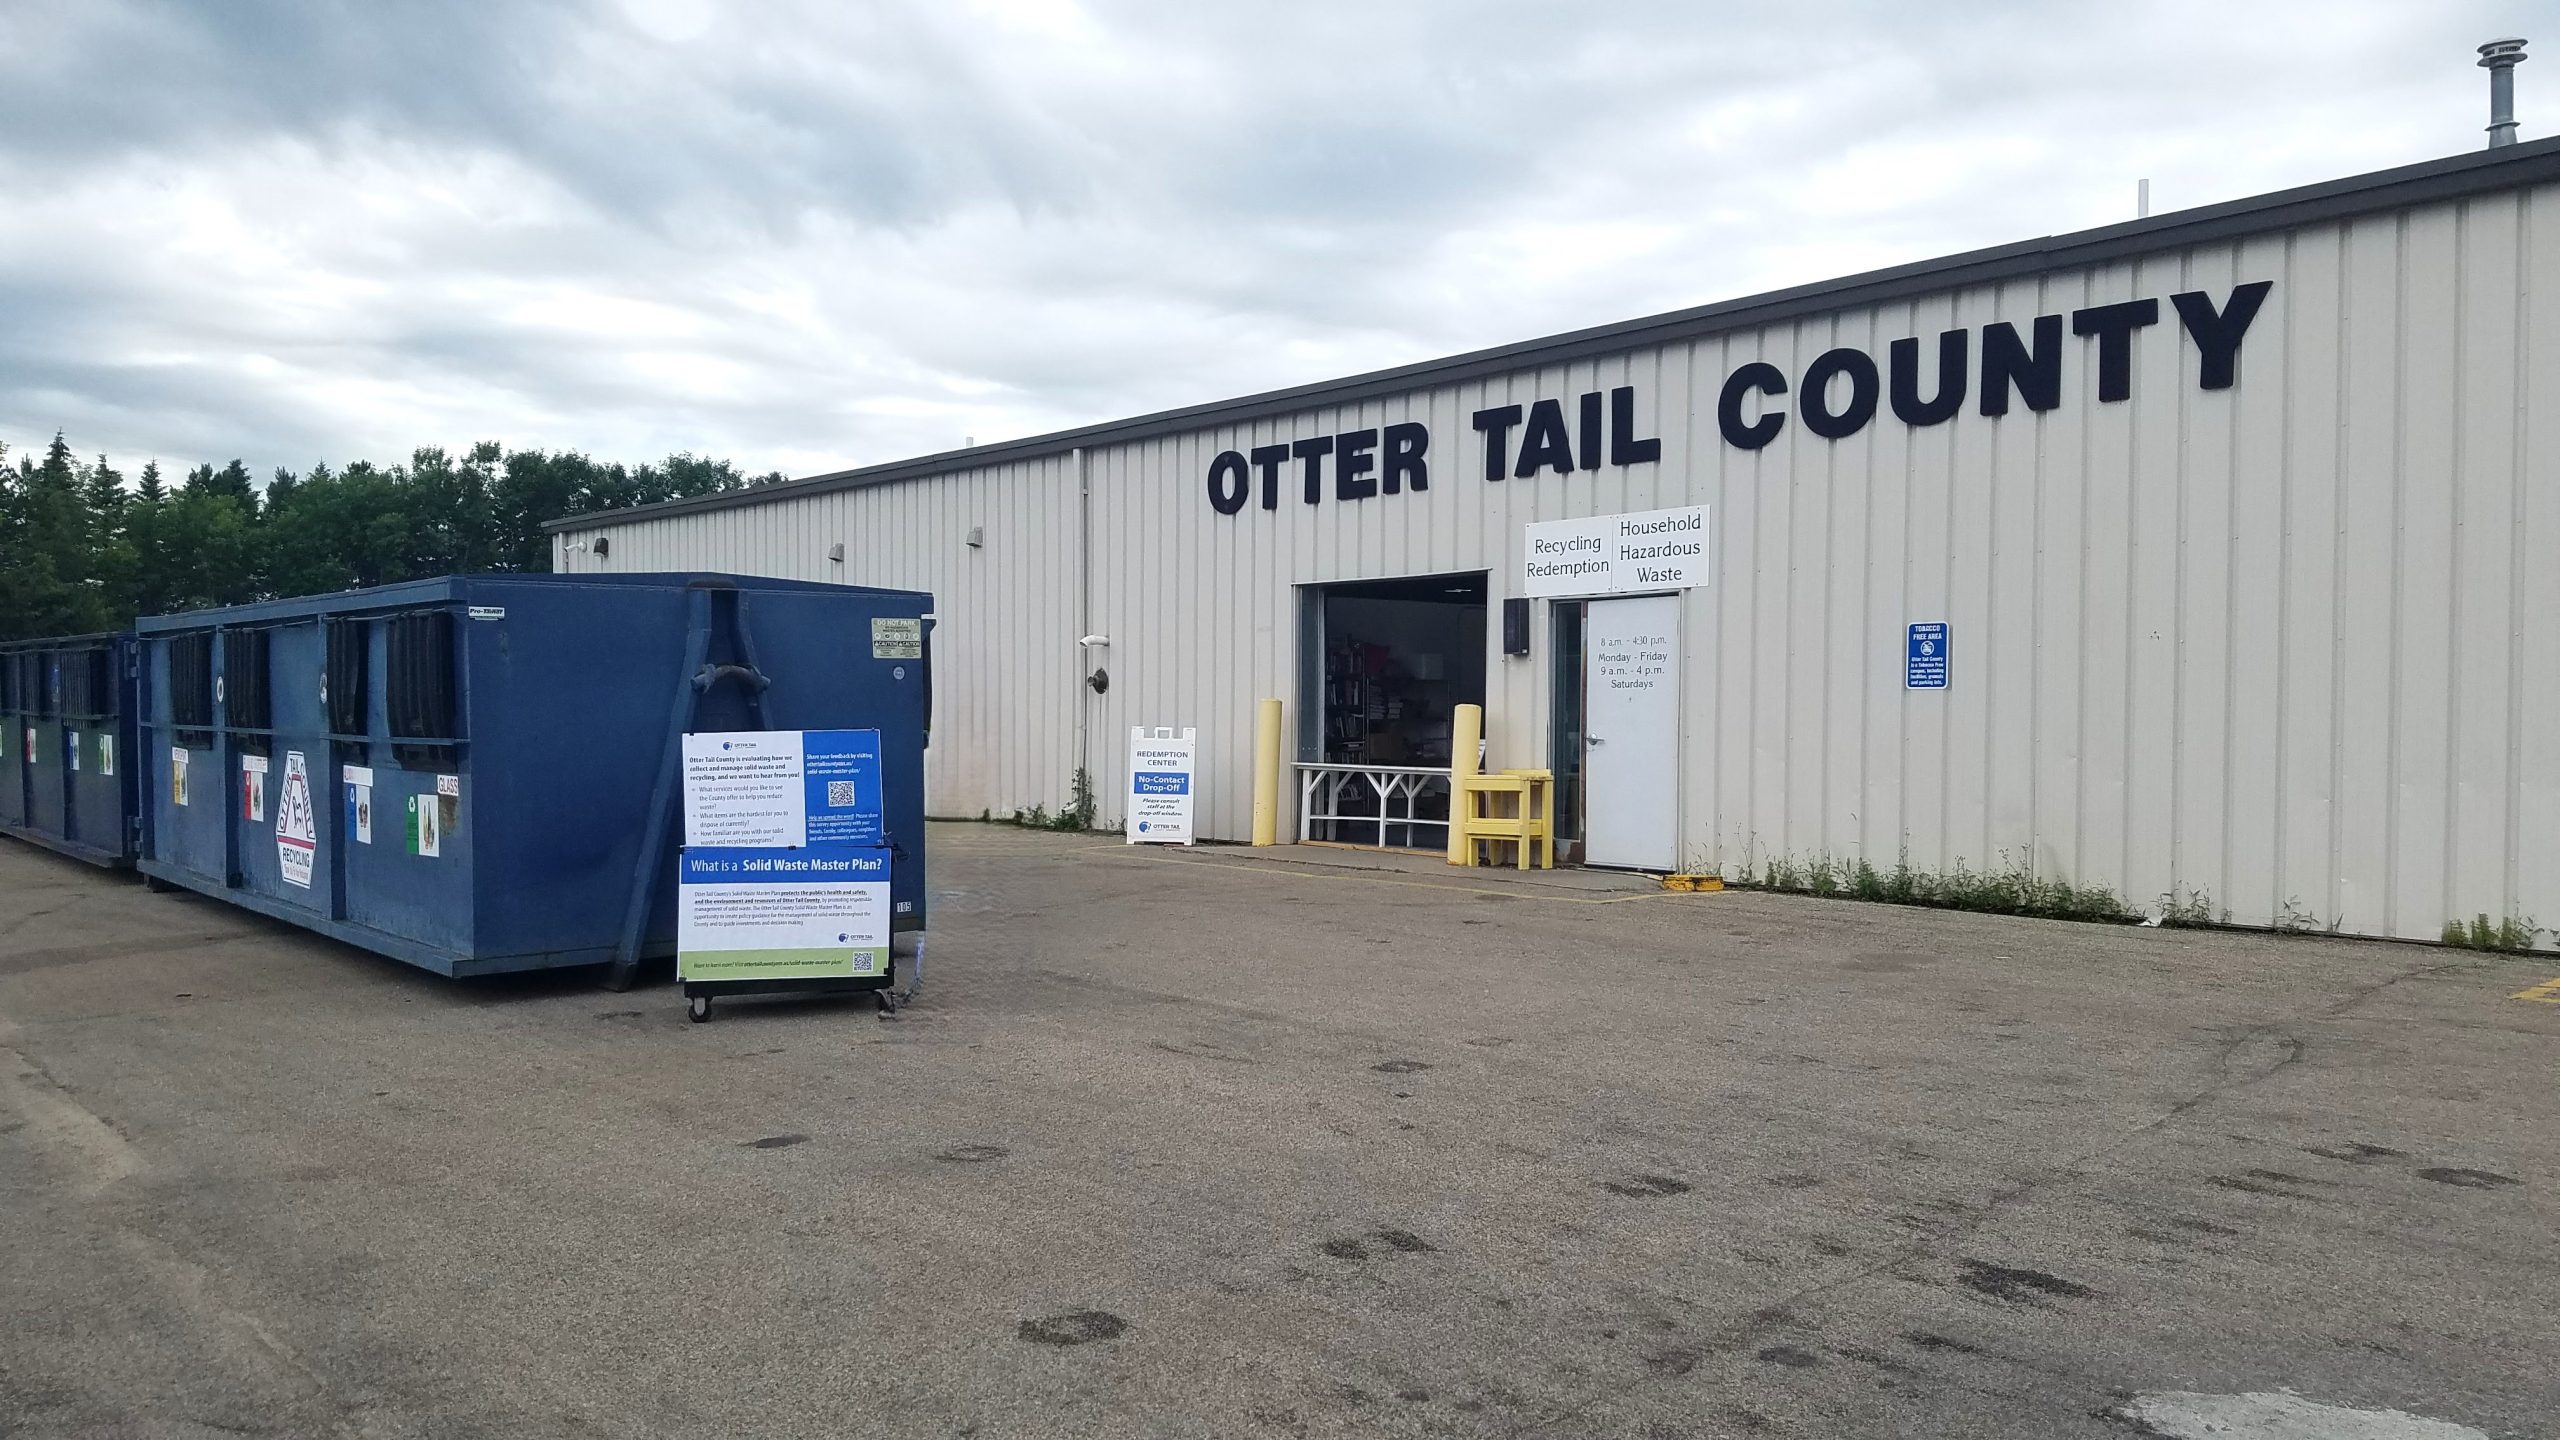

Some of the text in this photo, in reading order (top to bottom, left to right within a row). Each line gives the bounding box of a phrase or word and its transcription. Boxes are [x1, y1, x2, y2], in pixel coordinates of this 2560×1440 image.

[1208, 279, 2274, 516] OTTER TAIL COUNTY
[1621, 514, 1700, 536] Household
[1536, 536, 1601, 556] Recycling
[1621, 542, 1700, 560] Hazardous
[1527, 559, 1609, 578] Redemption
[1637, 568, 1682, 582] Waste
[1601, 638, 1605, 646] 8
[1598, 653, 1631, 663] Monday
[1641, 652, 1667, 662] Friday
[1601, 666, 1606, 675] 9
[1637, 666, 1641, 674] 4
[1645, 668, 1664, 676] p.m.
[1611, 679, 1654, 690] Saturdays
[439, 777, 458, 794] GLASS
[1143, 784, 1180, 792] Drop-Off
[283, 848, 310, 867] RECYCLING
[691, 858, 882, 871] What is a Solid Waste Master Plan?
[897, 902, 911, 912] 105
